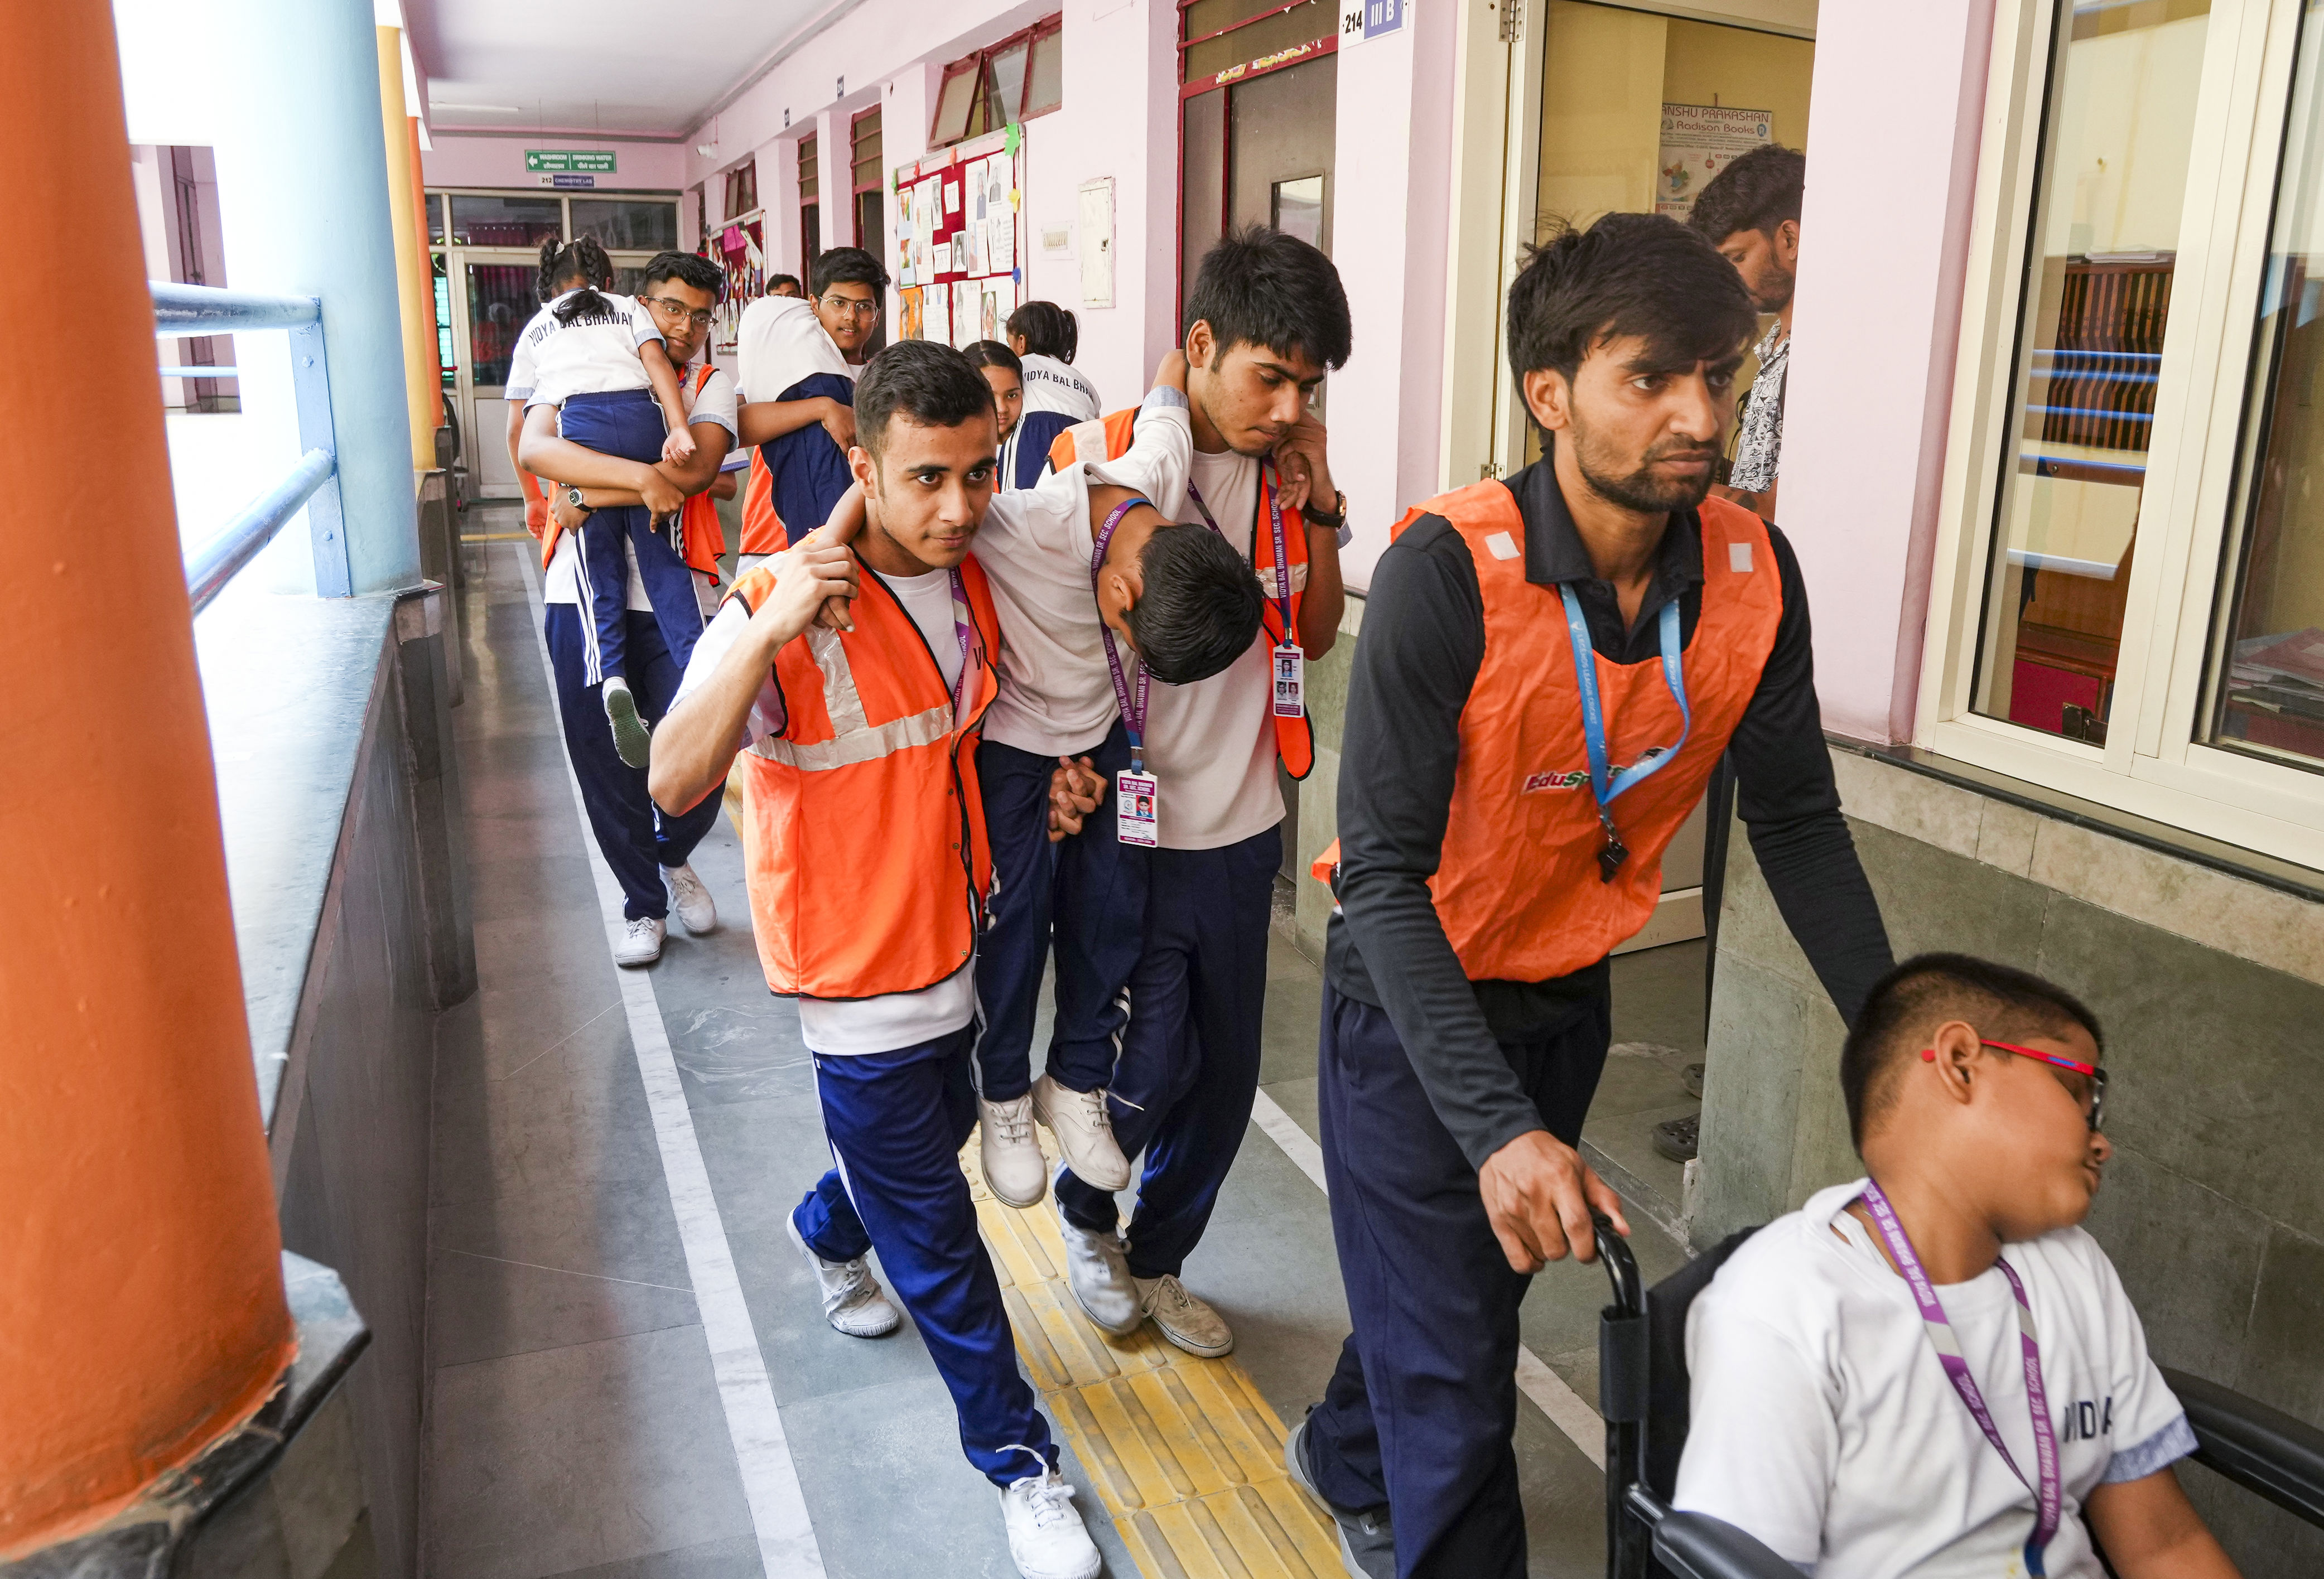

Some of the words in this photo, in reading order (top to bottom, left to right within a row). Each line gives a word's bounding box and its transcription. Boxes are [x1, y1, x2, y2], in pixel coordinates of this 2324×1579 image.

[1345, 10, 1362, 33] 214
[1371, 1, 1383, 27] III
[1386, 0, 1395, 22] B
[1702, 109, 1769, 123] PRAKASHAN
[1677, 120, 1720, 132] Radison
[1724, 124, 1755, 134] Books
[529, 320, 556, 347] VIDYA
[1053, 374, 1071, 387] BAL
[1103, 509, 1121, 529] SCHOOL
[1098, 529, 1109, 541] SEC.
[1274, 534, 1282, 544] SR.
[1275, 544, 1284, 569] BHAWAN
[950, 571, 958, 588] VIDYA
[1114, 674, 1126, 697] BHAWAN
[1119, 697, 1129, 708] BAL
[1122, 707, 1132, 722] VIDYA
[2025, 1356, 2041, 1394] SCHOOL
